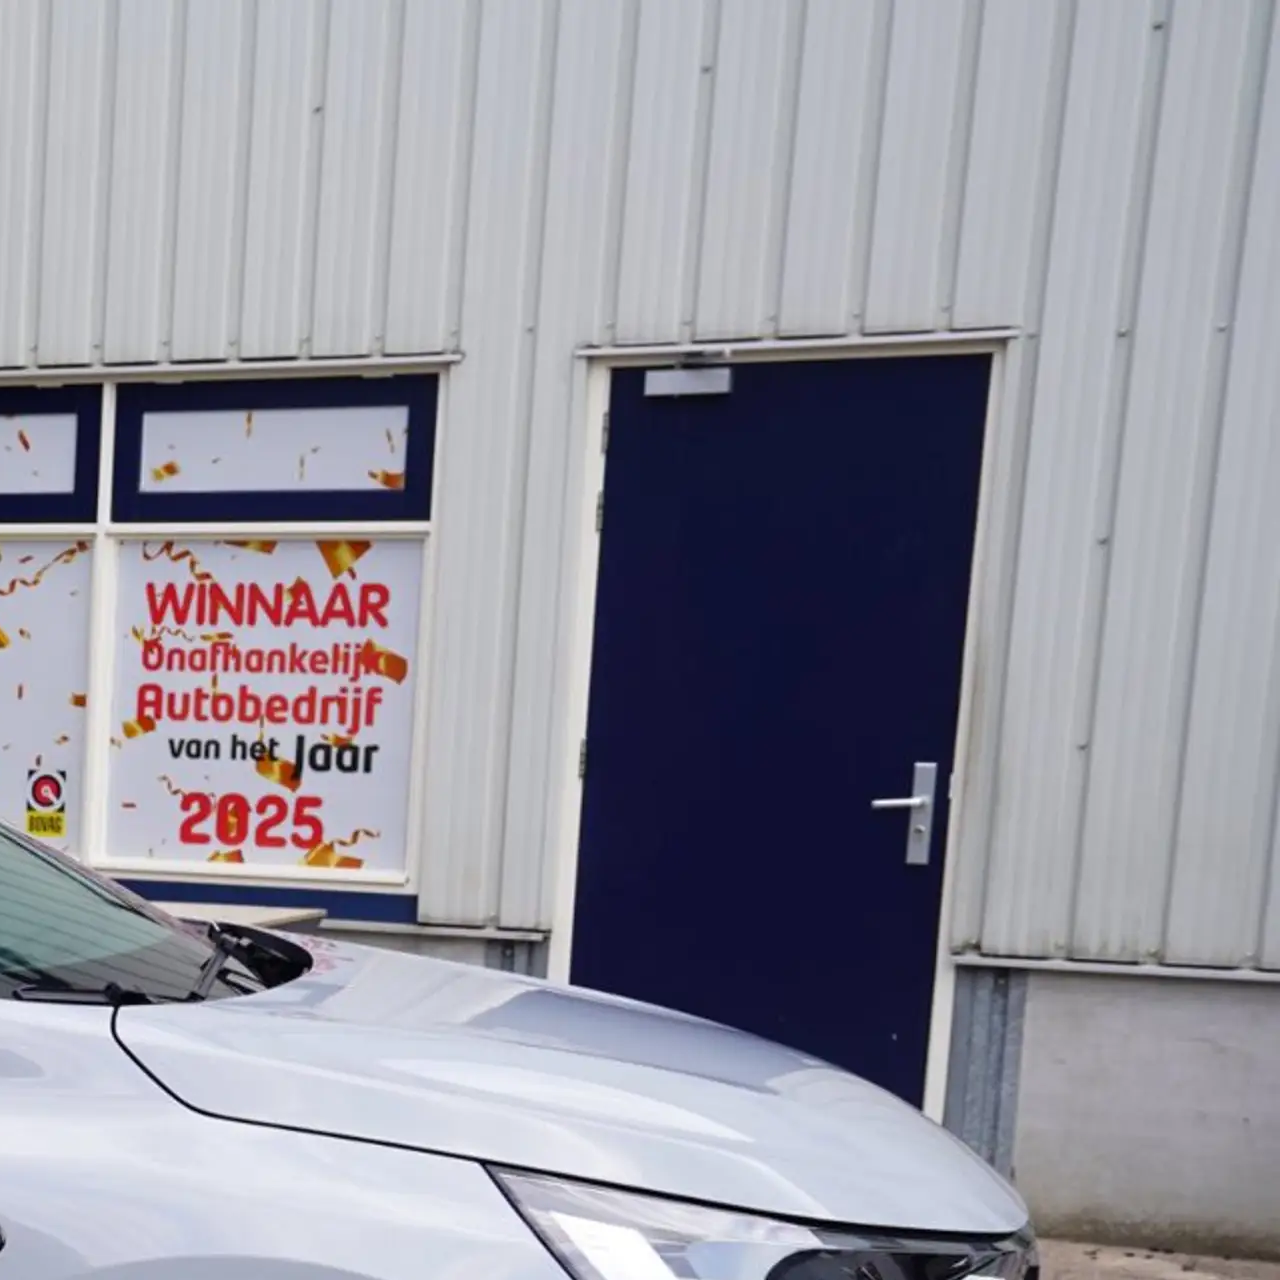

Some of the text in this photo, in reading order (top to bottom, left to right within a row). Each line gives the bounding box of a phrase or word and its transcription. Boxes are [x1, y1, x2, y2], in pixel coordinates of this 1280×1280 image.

[145, 582, 390, 628] WINNAAR
[141, 638, 383, 681] Onafhankelijk
[137, 683, 383, 735] Autobedrijf
[168, 734, 379, 780] van het Jaar
[28, 815, 62, 833] BOVAG
[180, 792, 324, 849] 2025
